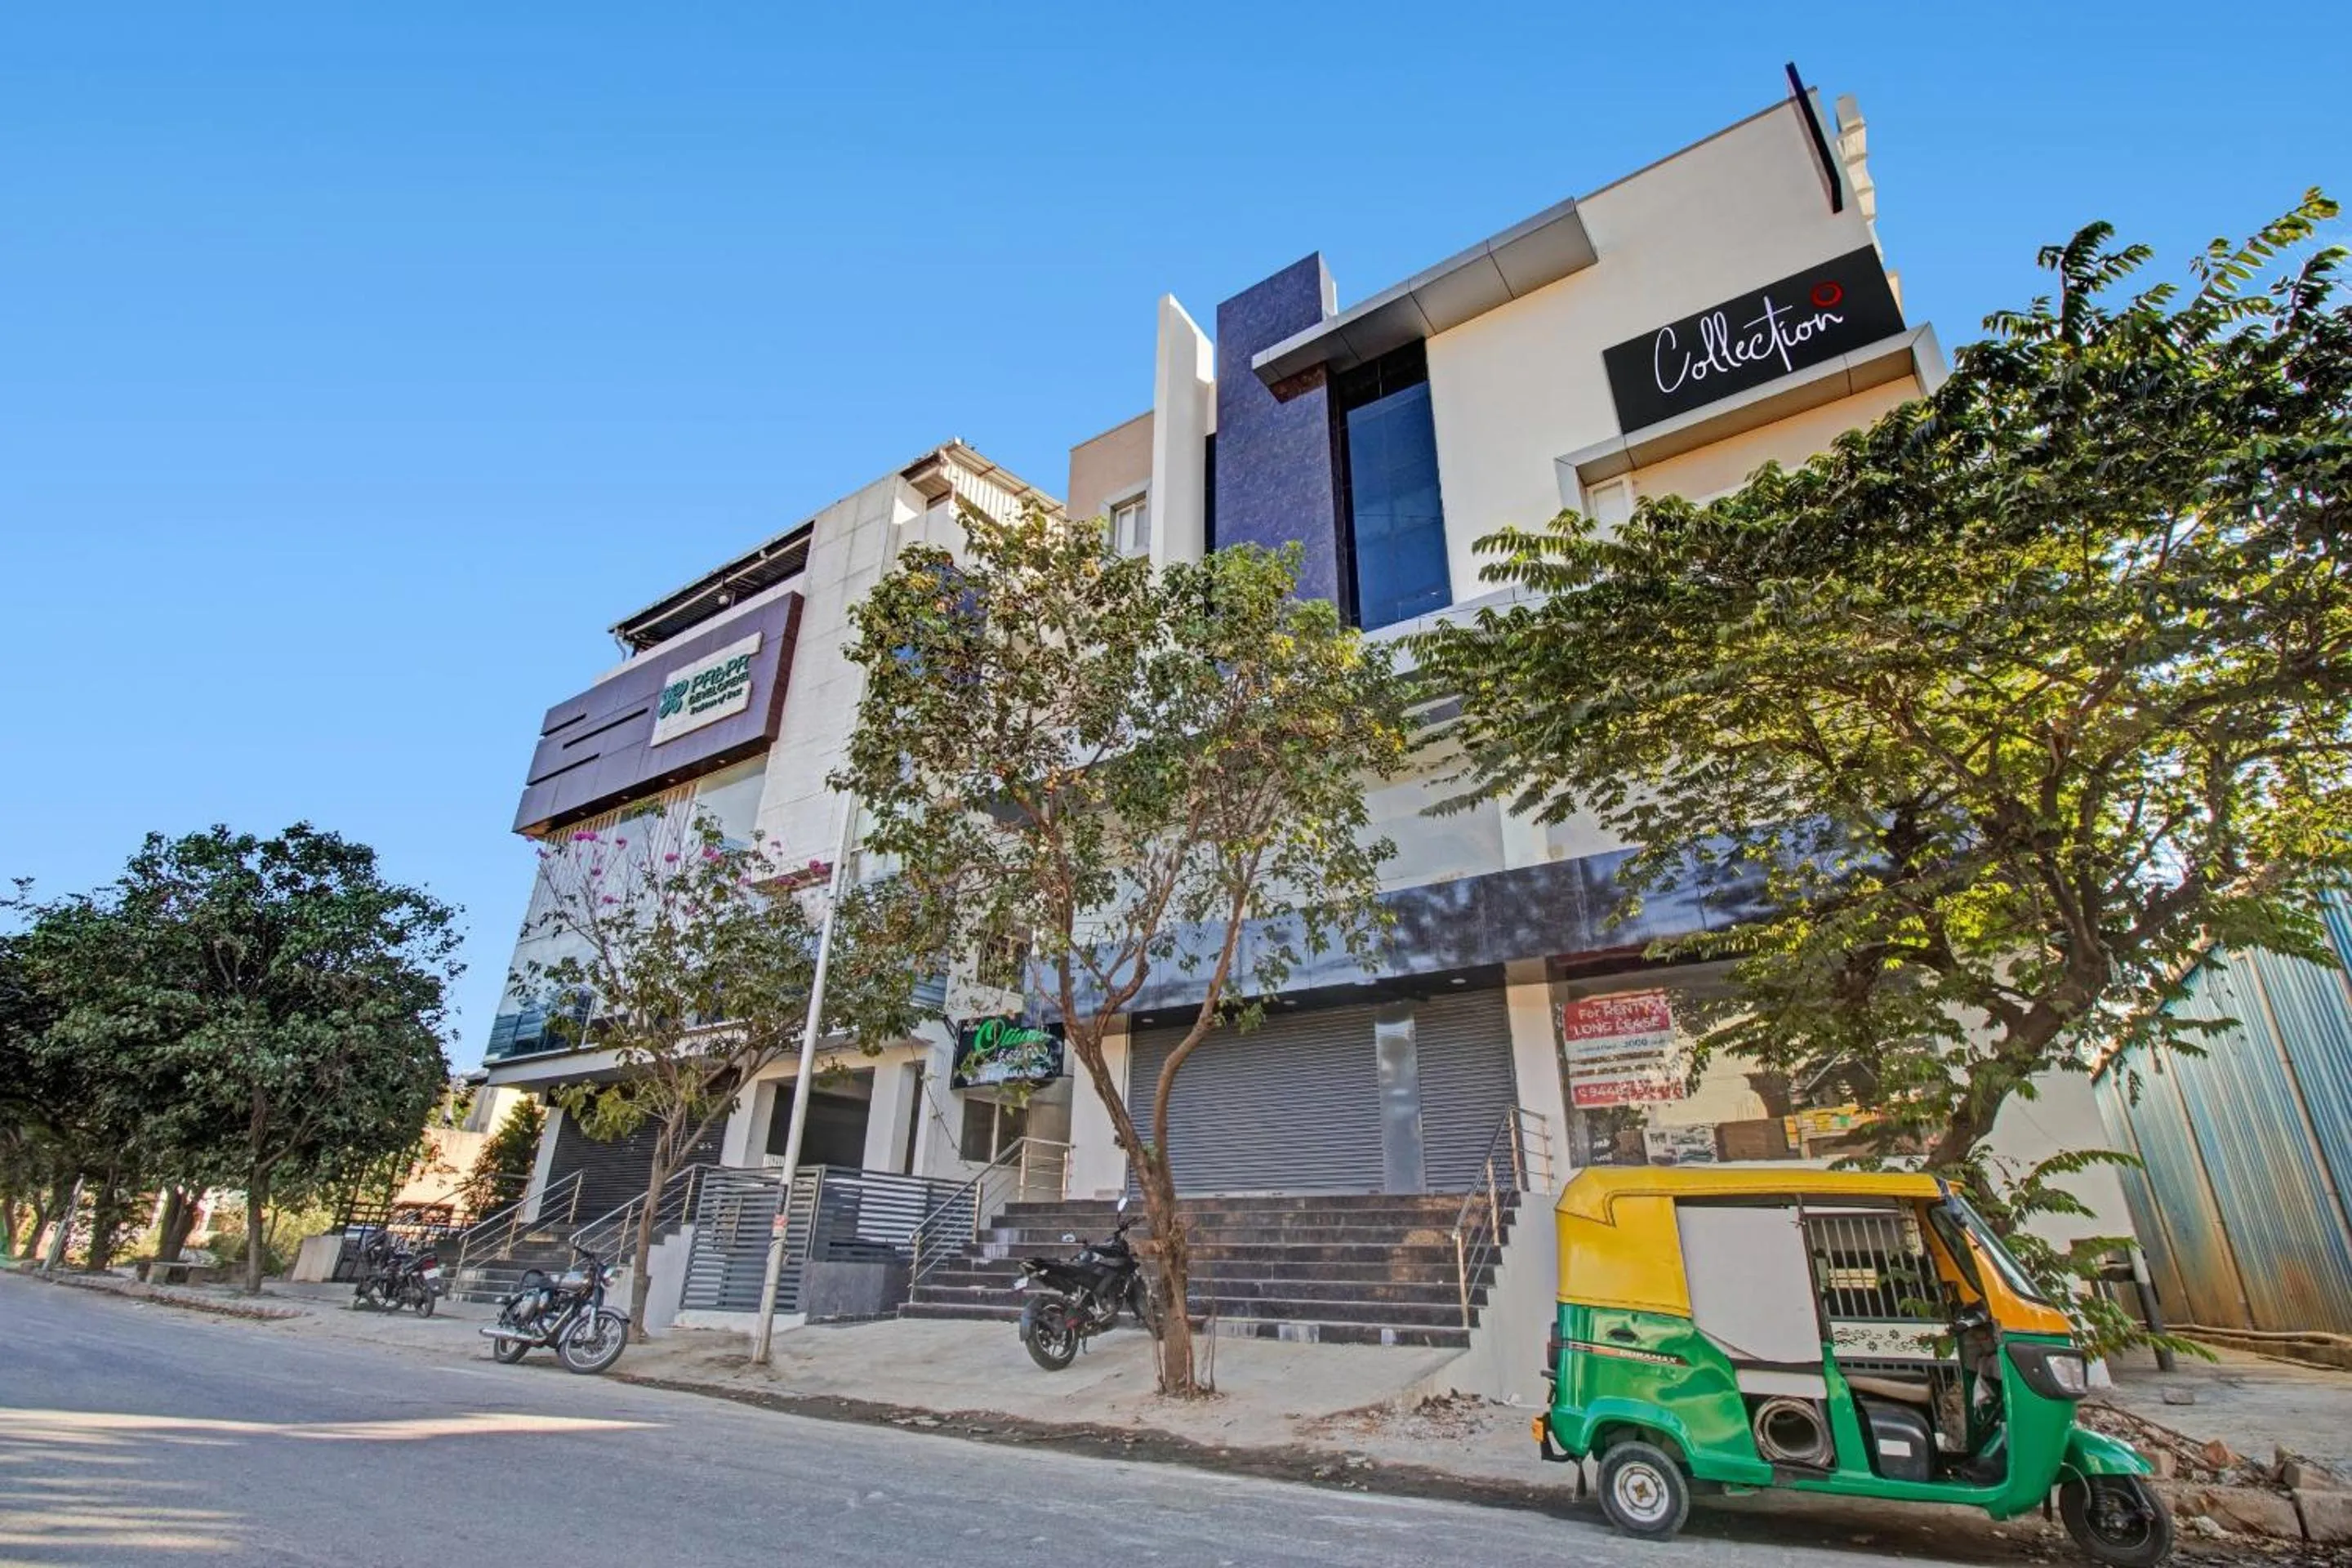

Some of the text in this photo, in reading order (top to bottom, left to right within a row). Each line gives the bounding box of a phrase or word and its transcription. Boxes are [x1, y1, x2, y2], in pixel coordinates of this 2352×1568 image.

[1655, 295, 1843, 393] Collection
[1578, 1008, 1600, 1020] For
[1603, 1001, 1641, 1017] RENT
[1574, 1021, 1612, 1036] LONG
[1619, 1350, 1677, 1364] DURAMAX
